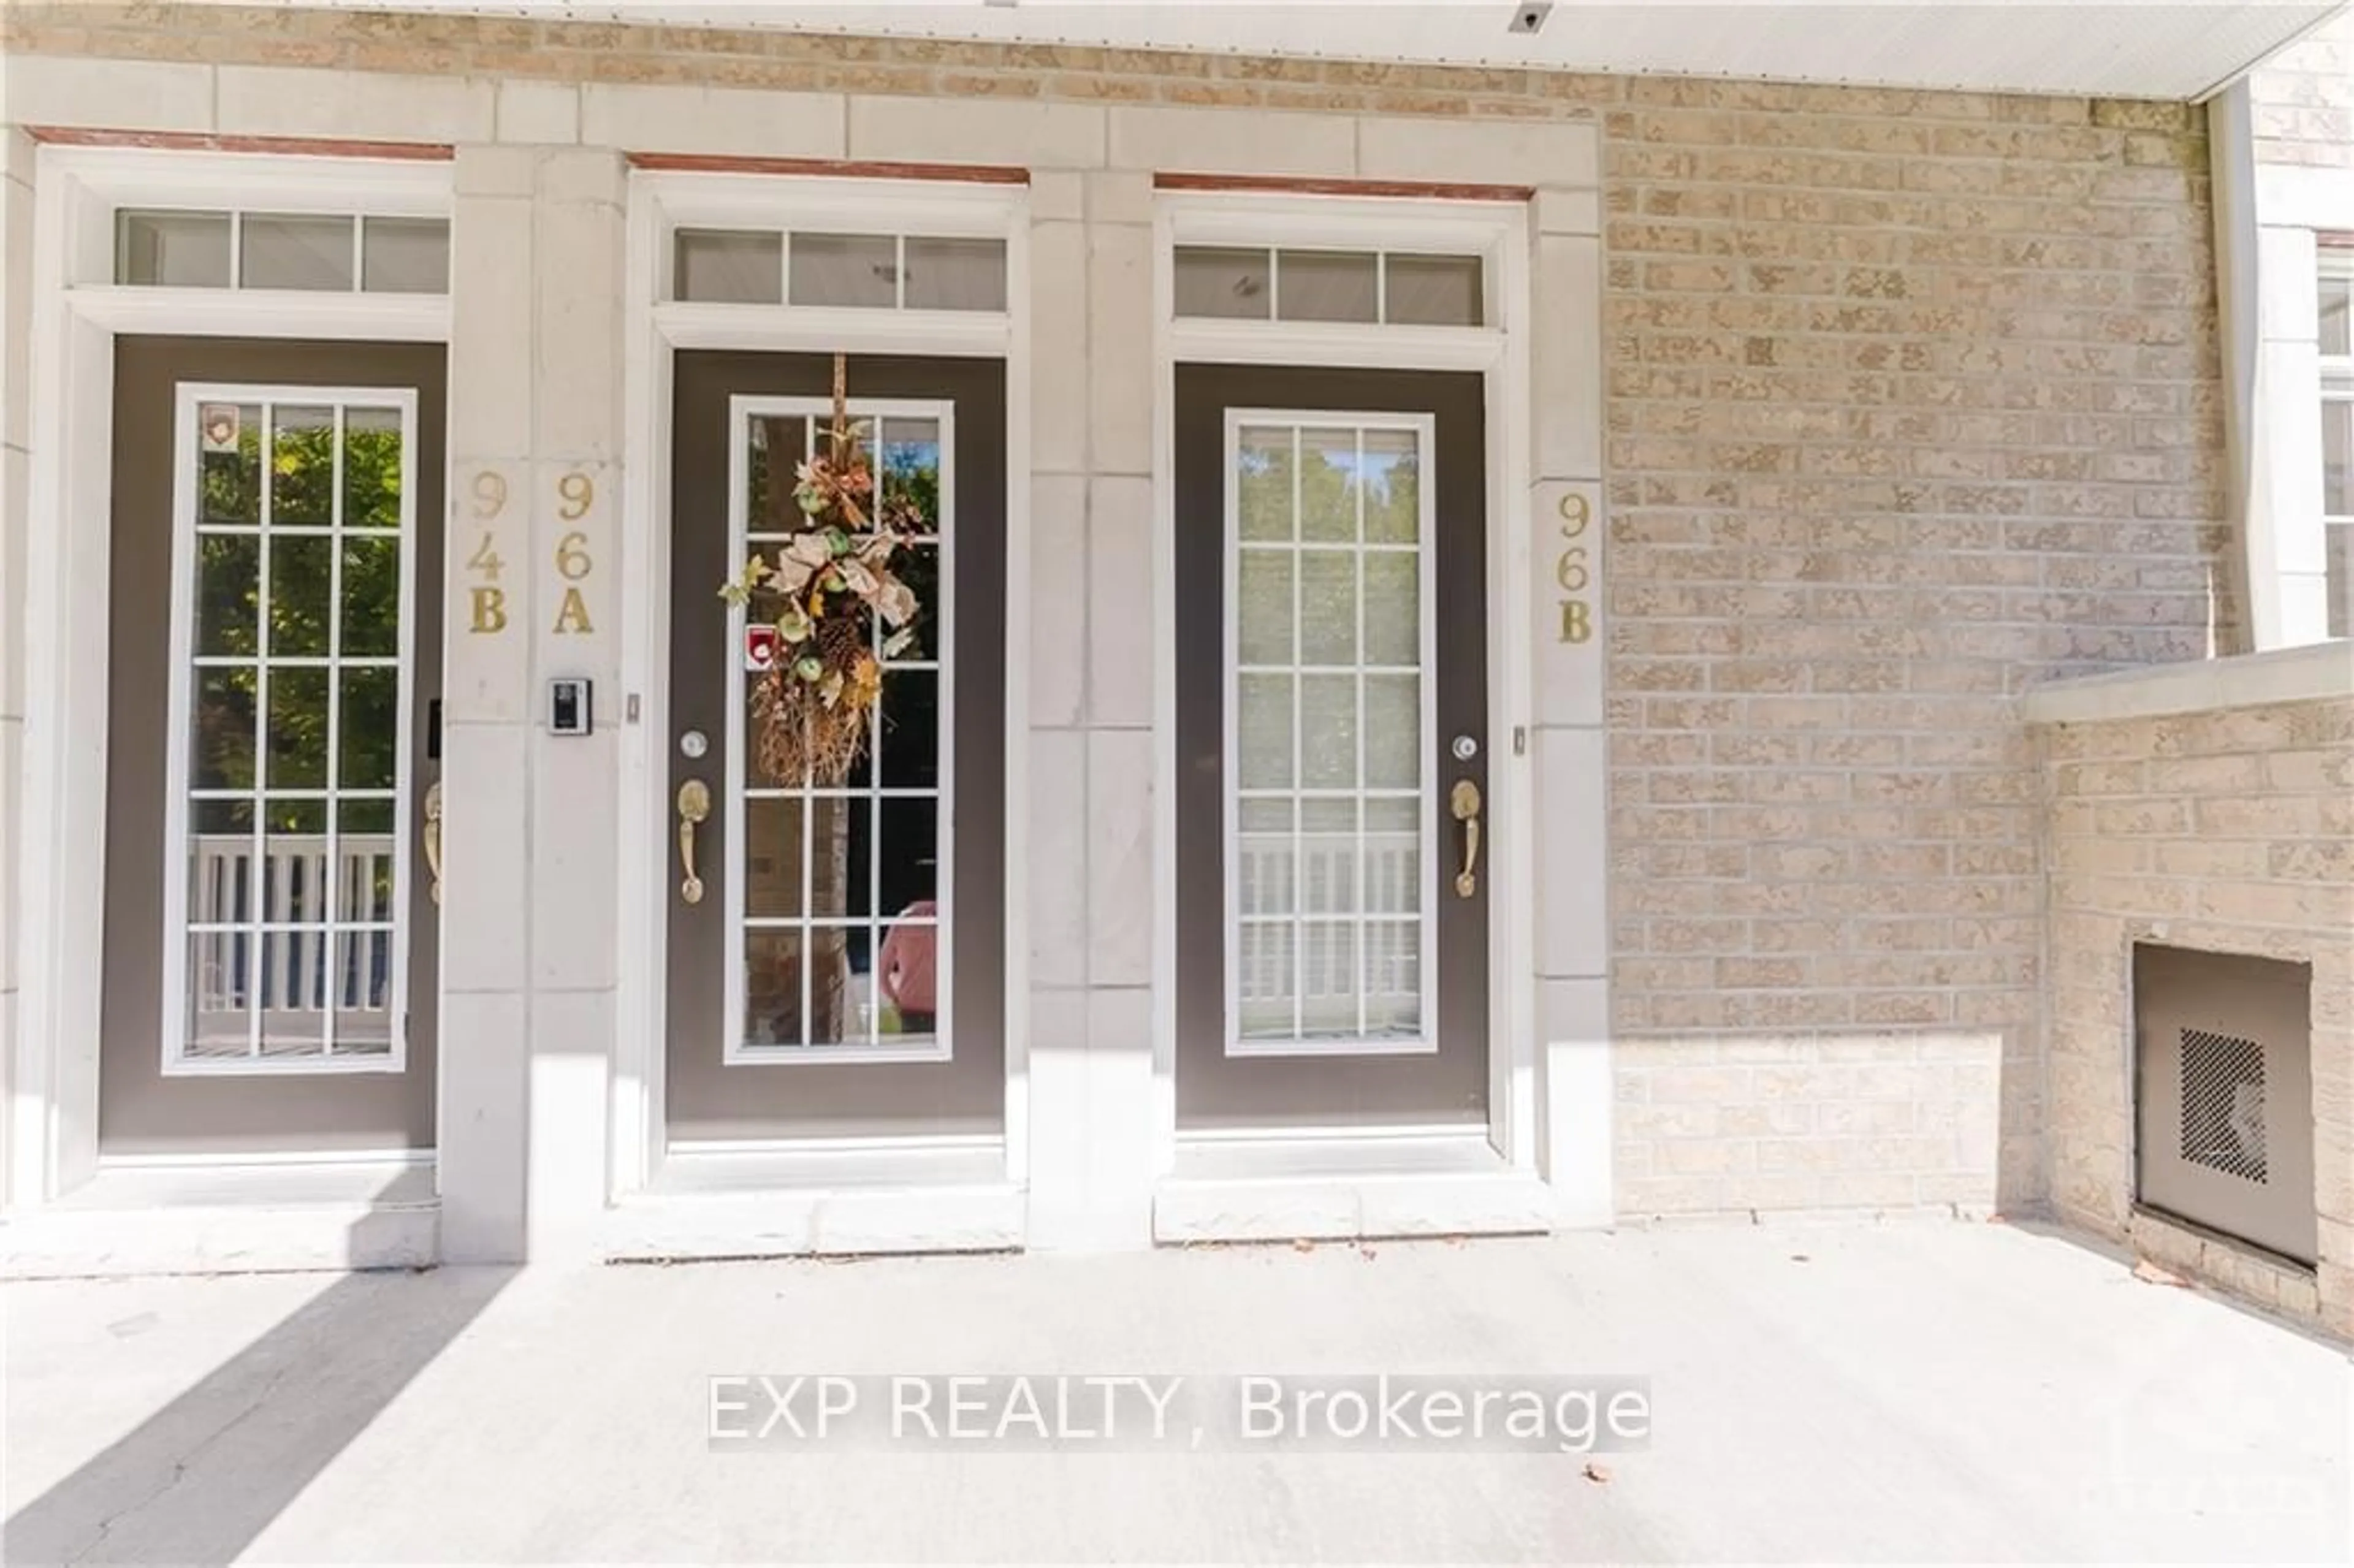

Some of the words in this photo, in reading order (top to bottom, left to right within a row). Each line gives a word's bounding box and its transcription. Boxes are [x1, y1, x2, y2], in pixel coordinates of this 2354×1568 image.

[467, 471, 508, 633] 94B
[553, 474, 593, 633] 96A
[1558, 493, 1591, 644] 96B
